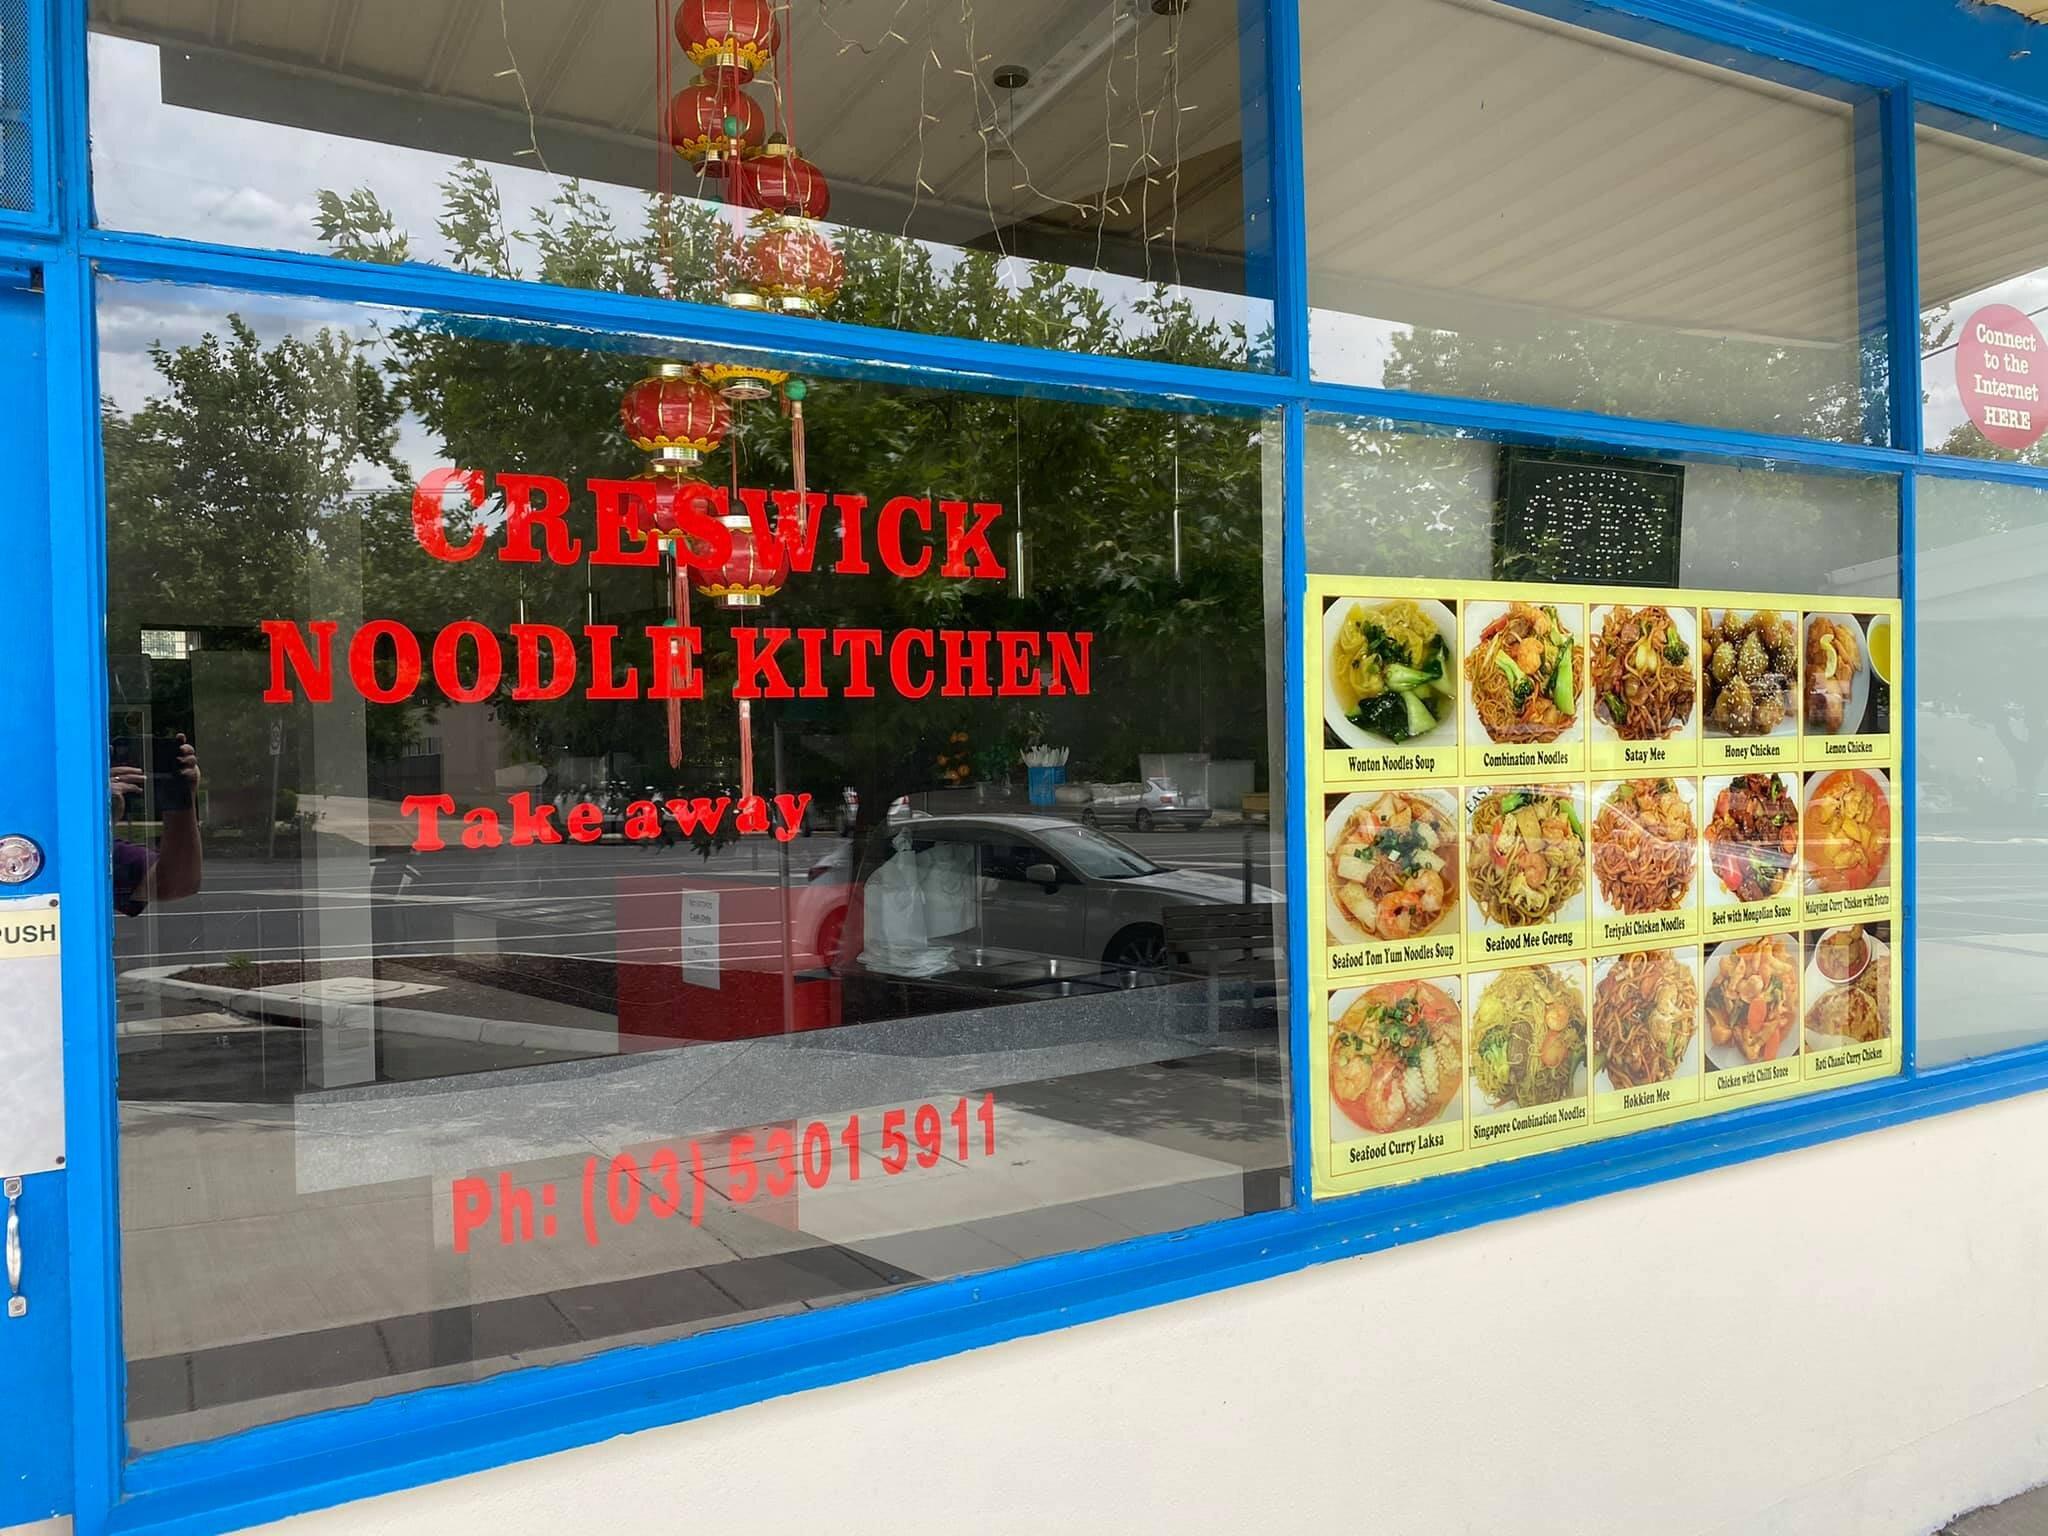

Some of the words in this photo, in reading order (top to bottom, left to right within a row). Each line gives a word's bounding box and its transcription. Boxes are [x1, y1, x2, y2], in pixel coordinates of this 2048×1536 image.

[1976, 323, 2037, 352] Connect
[1984, 349, 2000, 370] to
[2003, 352, 2029, 374] the
[1974, 374, 2039, 402] Internet
[1983, 405, 2031, 430] HERE
[410, 466, 1007, 579] CRESWICK
[260, 619, 704, 704] NOODLE
[730, 626, 1094, 699] KITCHEN
[1483, 751, 1535, 767] Combination
[1537, 750, 1568, 766] Noodles
[1625, 748, 1648, 764] Satay
[1650, 747, 1666, 760] Mee
[1725, 744, 1749, 759] Honey
[1750, 744, 1780, 757] Chicken
[1825, 741, 1846, 755] Lemon
[1847, 741, 1873, 754] Chicken
[1348, 756, 1381, 772] Wonton
[1382, 755, 1414, 771] Noodles
[1415, 754, 1435, 772] Soup
[1829, 899, 1843, 912] Curry
[1844, 897, 1863, 909] Chicken
[1863, 894, 1874, 907] with
[1712, 910, 1726, 925] Beef
[1727, 908, 1742, 923] with
[1743, 906, 1774, 923] Mongolian
[1774, 905, 1791, 918] Sauce
[0, 924, 56, 944] USH
[1604, 923, 1633, 939] Teriyaki
[1634, 920, 1660, 935] Chicken
[1660, 918, 1685, 932] Noodles
[1485, 934, 1521, 952] Seafood
[1523, 933, 1540, 948] Mee
[1542, 931, 1573, 948] Goreng
[1332, 950, 1364, 970] Seafood
[1365, 949, 1383, 966] Tom
[1384, 948, 1403, 964] Yum
[1404, 945, 1434, 962] Noodles
[1435, 944, 1454, 960] Soup
[1846, 1051, 1861, 1065] Curry
[1862, 1048, 1882, 1061] Chicken
[1717, 1075, 1740, 1090] Chicken
[1741, 1072, 1756, 1086] with
[1756, 1068, 1772, 1083] Chilli
[1773, 1066, 1789, 1080] Sauce
[1623, 1092, 1655, 1109] Hokkien
[1656, 1089, 1670, 1103] Mee
[1473, 1119, 1511, 1140] Singapore
[1512, 1111, 1558, 1131] Combination
[1558, 1106, 1586, 1123] Noodles
[1349, 1142, 1387, 1163] Seafood
[1388, 1138, 1417, 1156] Curry
[1418, 1134, 1444, 1149] Laksa
[452, 1171, 558, 1255] Ph:
[581, 1141, 705, 1247] (03)
